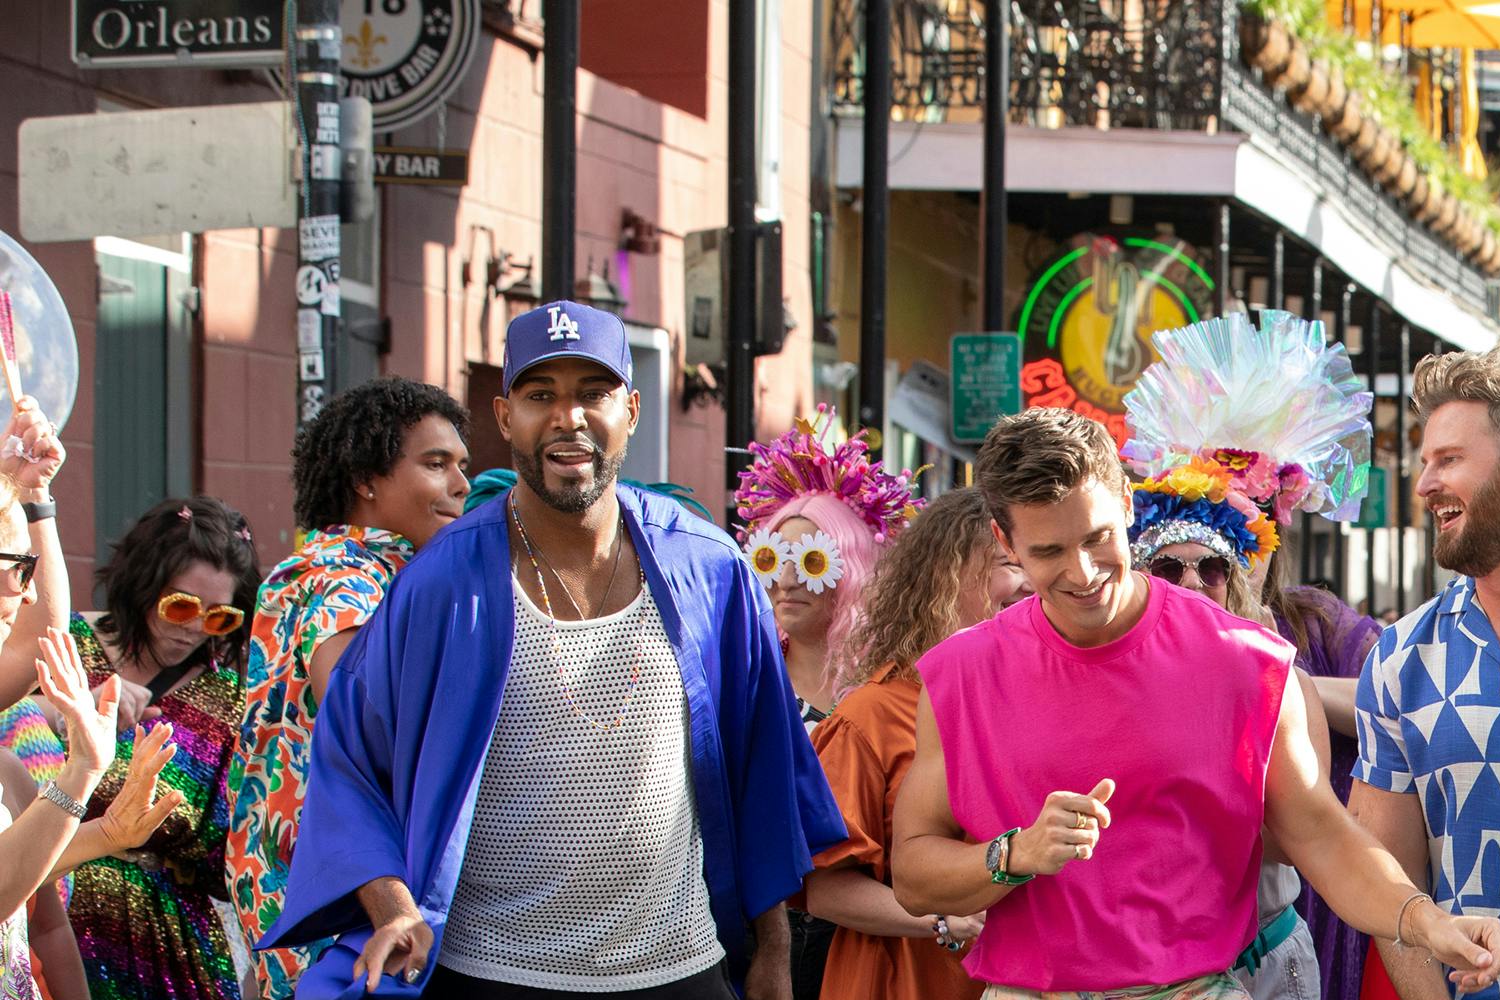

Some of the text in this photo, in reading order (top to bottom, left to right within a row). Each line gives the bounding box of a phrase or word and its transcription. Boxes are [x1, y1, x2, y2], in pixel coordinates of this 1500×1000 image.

[92, 6, 272, 49] Orleans
[350, 73, 402, 100] DIVE
[401, 43, 440, 86] BAR
[395, 156, 440, 177] BAR
[547, 306, 580, 341] LA
